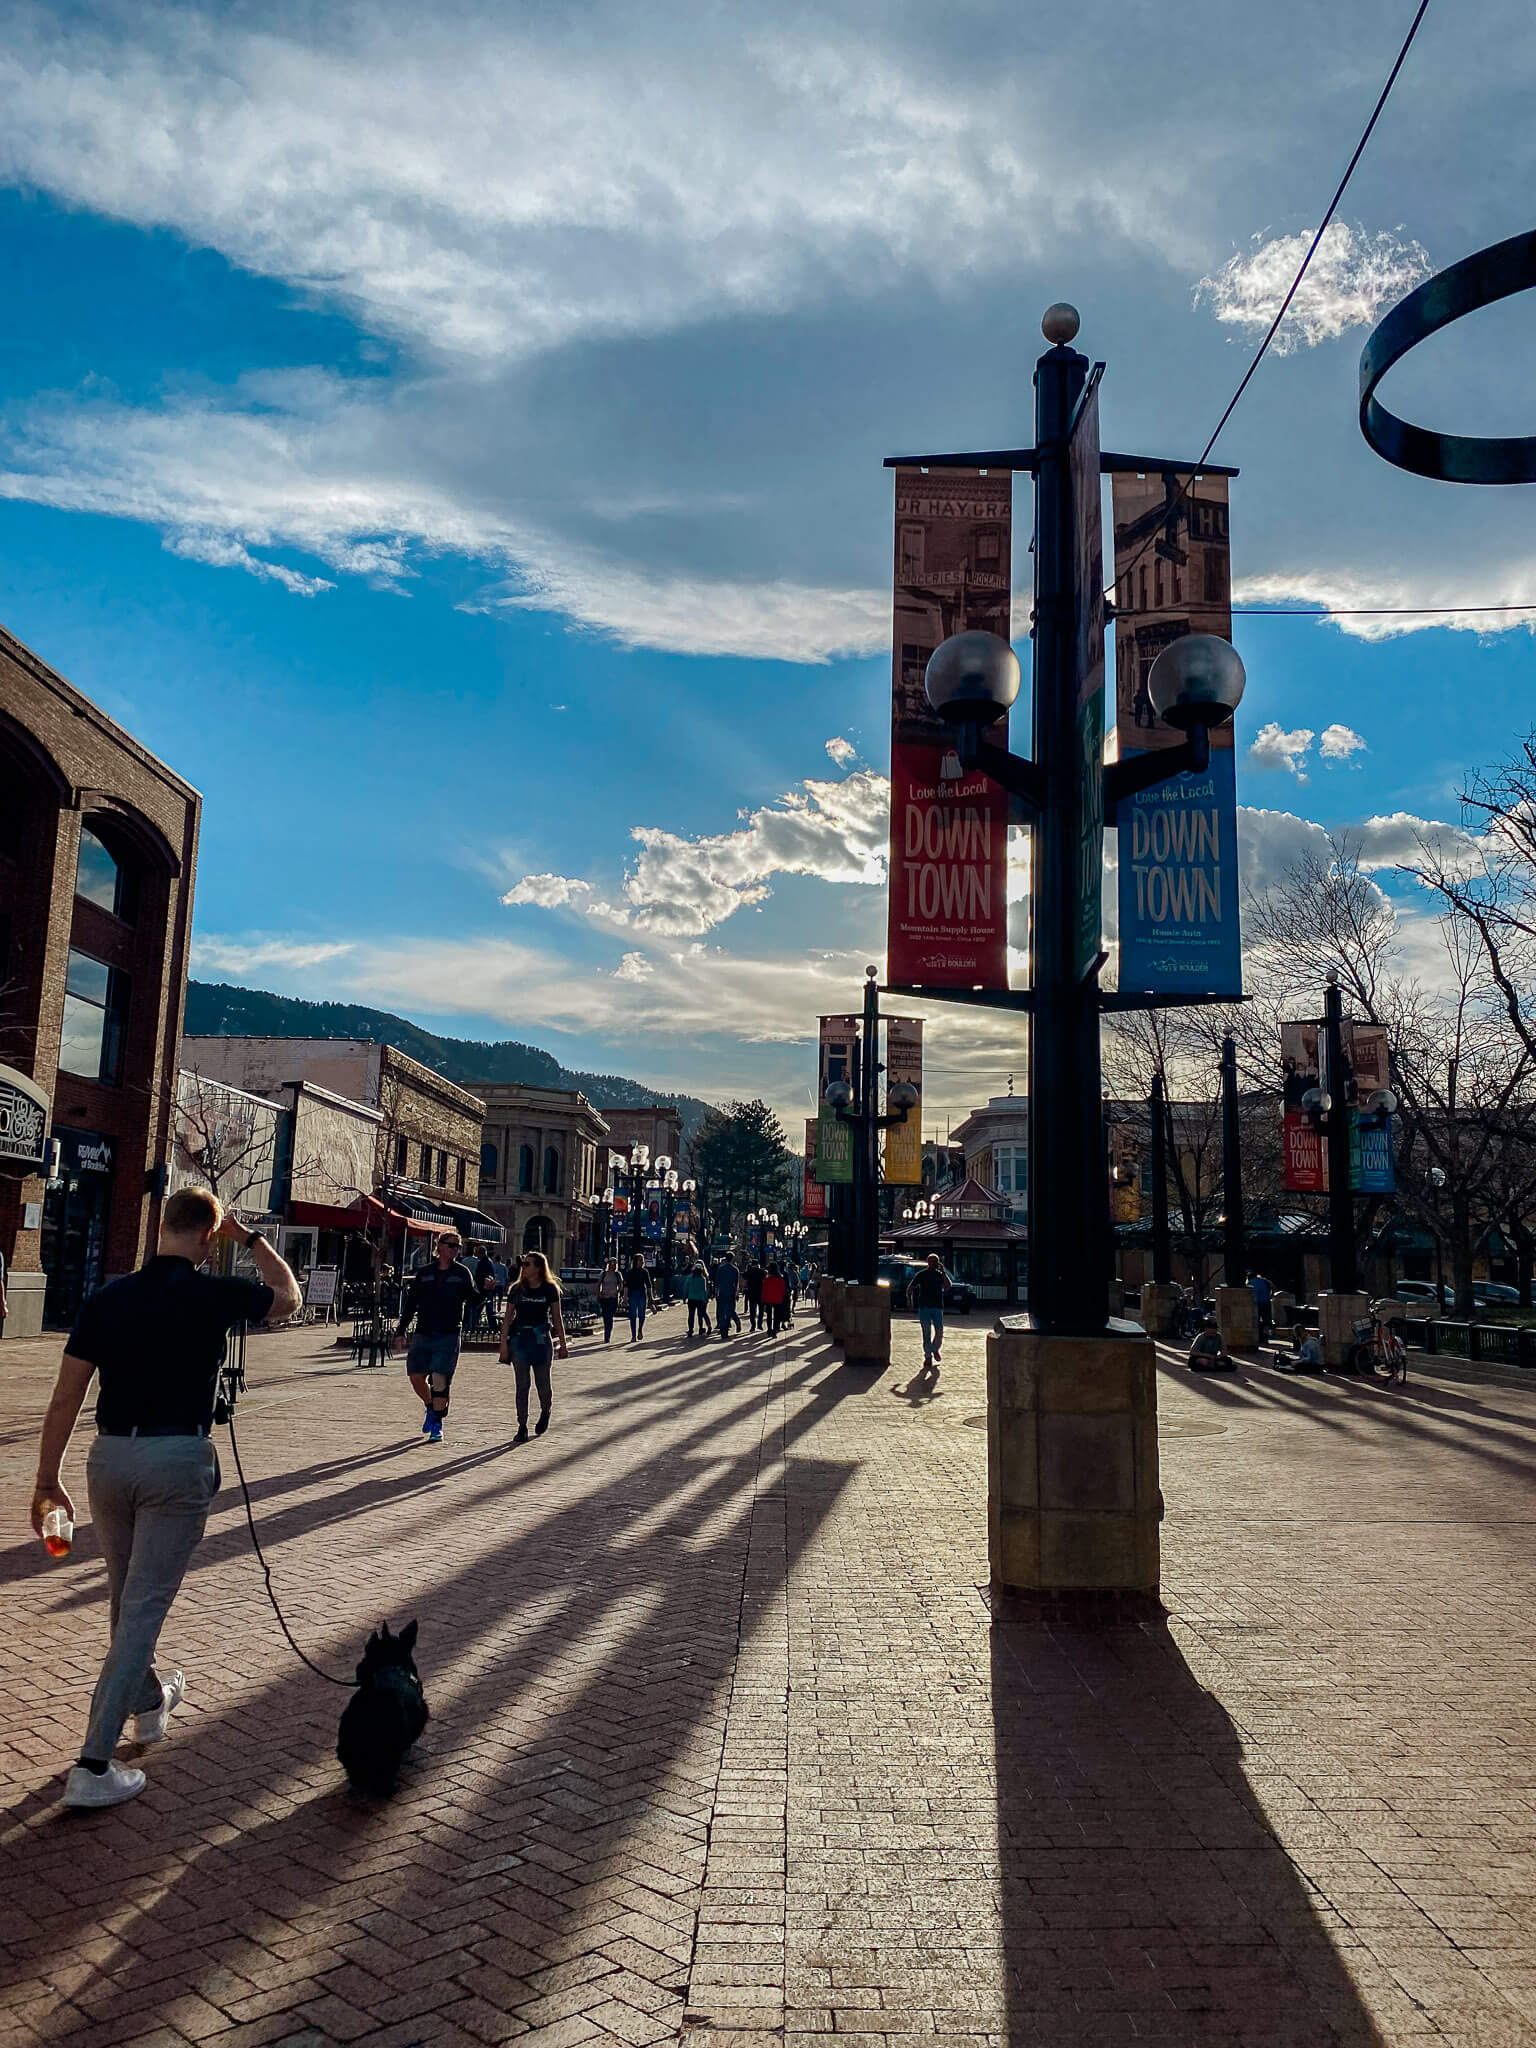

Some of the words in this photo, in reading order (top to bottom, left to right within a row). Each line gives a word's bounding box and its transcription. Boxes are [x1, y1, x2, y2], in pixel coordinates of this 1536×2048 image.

[909, 783, 936, 801] Love
[938, 781, 954, 799] the
[955, 777, 989, 797] Local
[1162, 786, 1178, 802] the
[1180, 779, 1215, 799] Local
[905, 804, 991, 860] DOWN
[1131, 807, 1219, 862] DOWN
[903, 862, 991, 920] TOWN
[1131, 865, 1222, 923] TOWN
[940, 924, 969, 935] Supply
[821, 1123, 849, 1143] DOWN
[1290, 1131, 1318, 1149] DOWN
[1361, 1133, 1388, 1150] DOWN
[821, 1142, 849, 1161] TOWN
[1290, 1149, 1319, 1169] TOWN
[1362, 1150, 1389, 1170] TOWN
